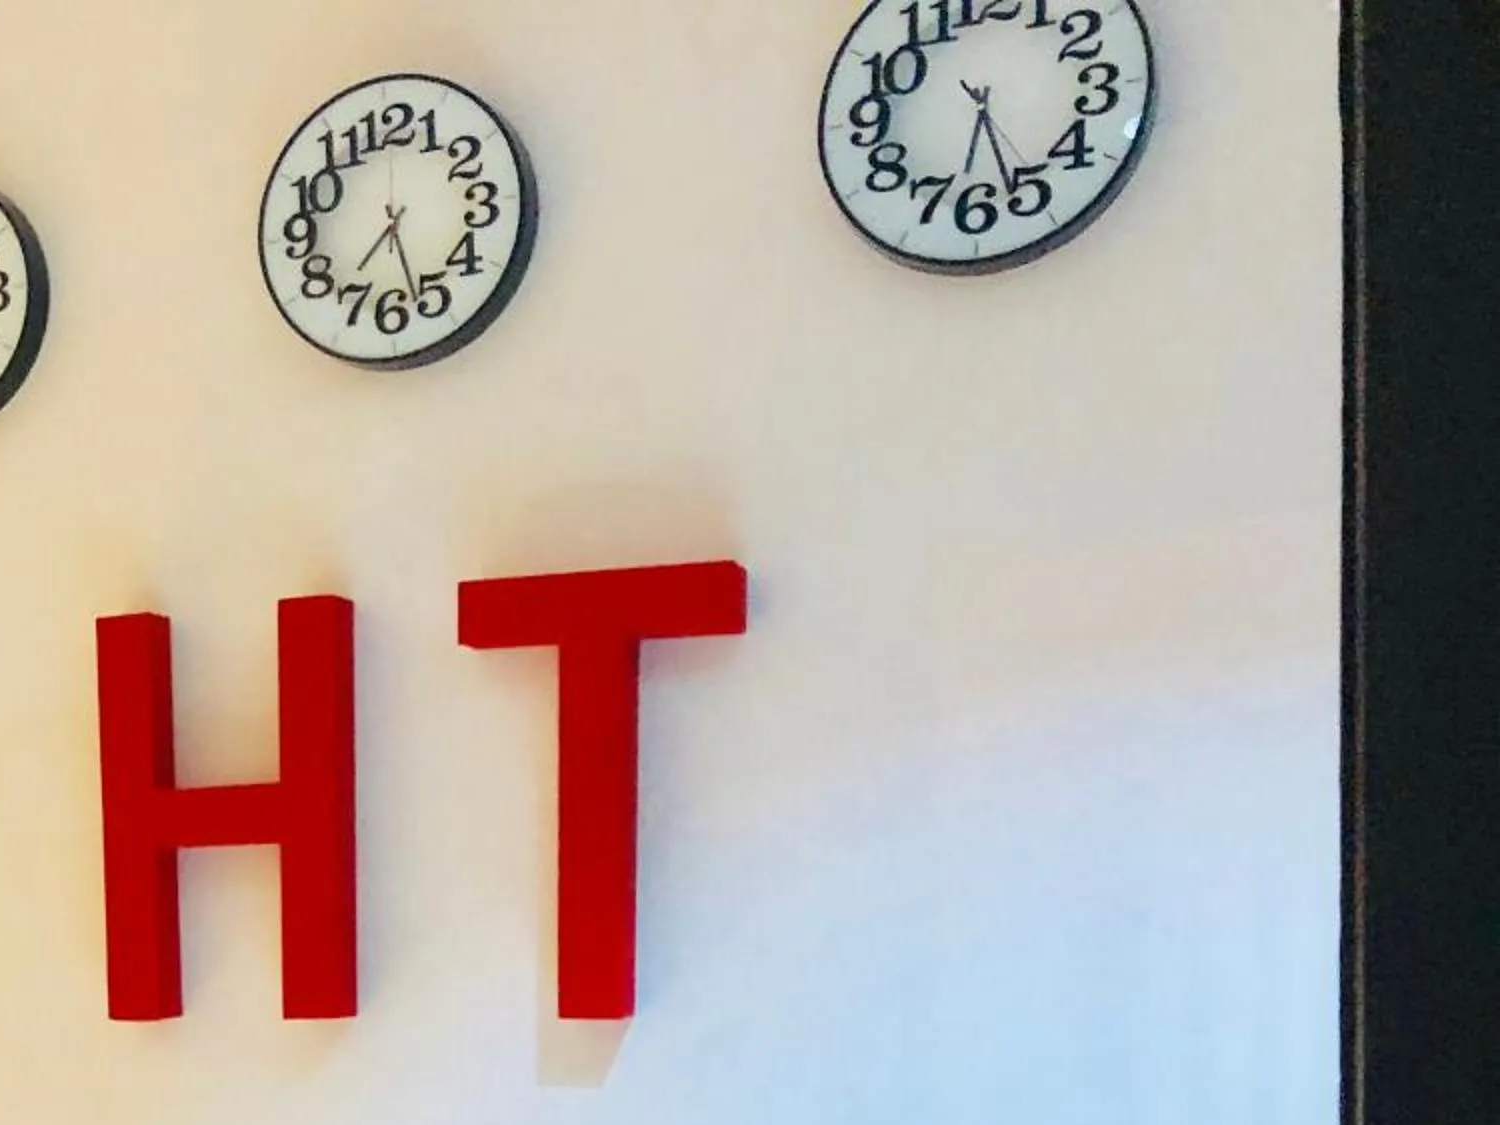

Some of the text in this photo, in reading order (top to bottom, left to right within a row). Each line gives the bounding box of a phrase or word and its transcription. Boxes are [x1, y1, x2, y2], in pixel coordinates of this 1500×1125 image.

[1057, 9, 1103, 62] 2
[861, 43, 928, 97] 10
[1074, 62, 1120, 115] 3
[359, 102, 415, 154] 12
[417, 109, 444, 153] 1
[849, 93, 891, 147] 9
[317, 125, 367, 171] 11
[448, 135, 483, 182] 2
[865, 142, 907, 192] 8
[1047, 119, 1095, 170] 4
[291, 167, 343, 215] 10
[463, 181, 500, 228] 3
[910, 174, 956, 225] 7
[954, 183, 998, 235] 6
[1007, 163, 1052, 216] 5
[283, 211, 318, 259] 9
[445, 231, 484, 277] 4
[301, 254, 335, 299] 8
[417, 271, 452, 318] 5
[337, 281, 372, 326] 7
[374, 288, 410, 335] 6
